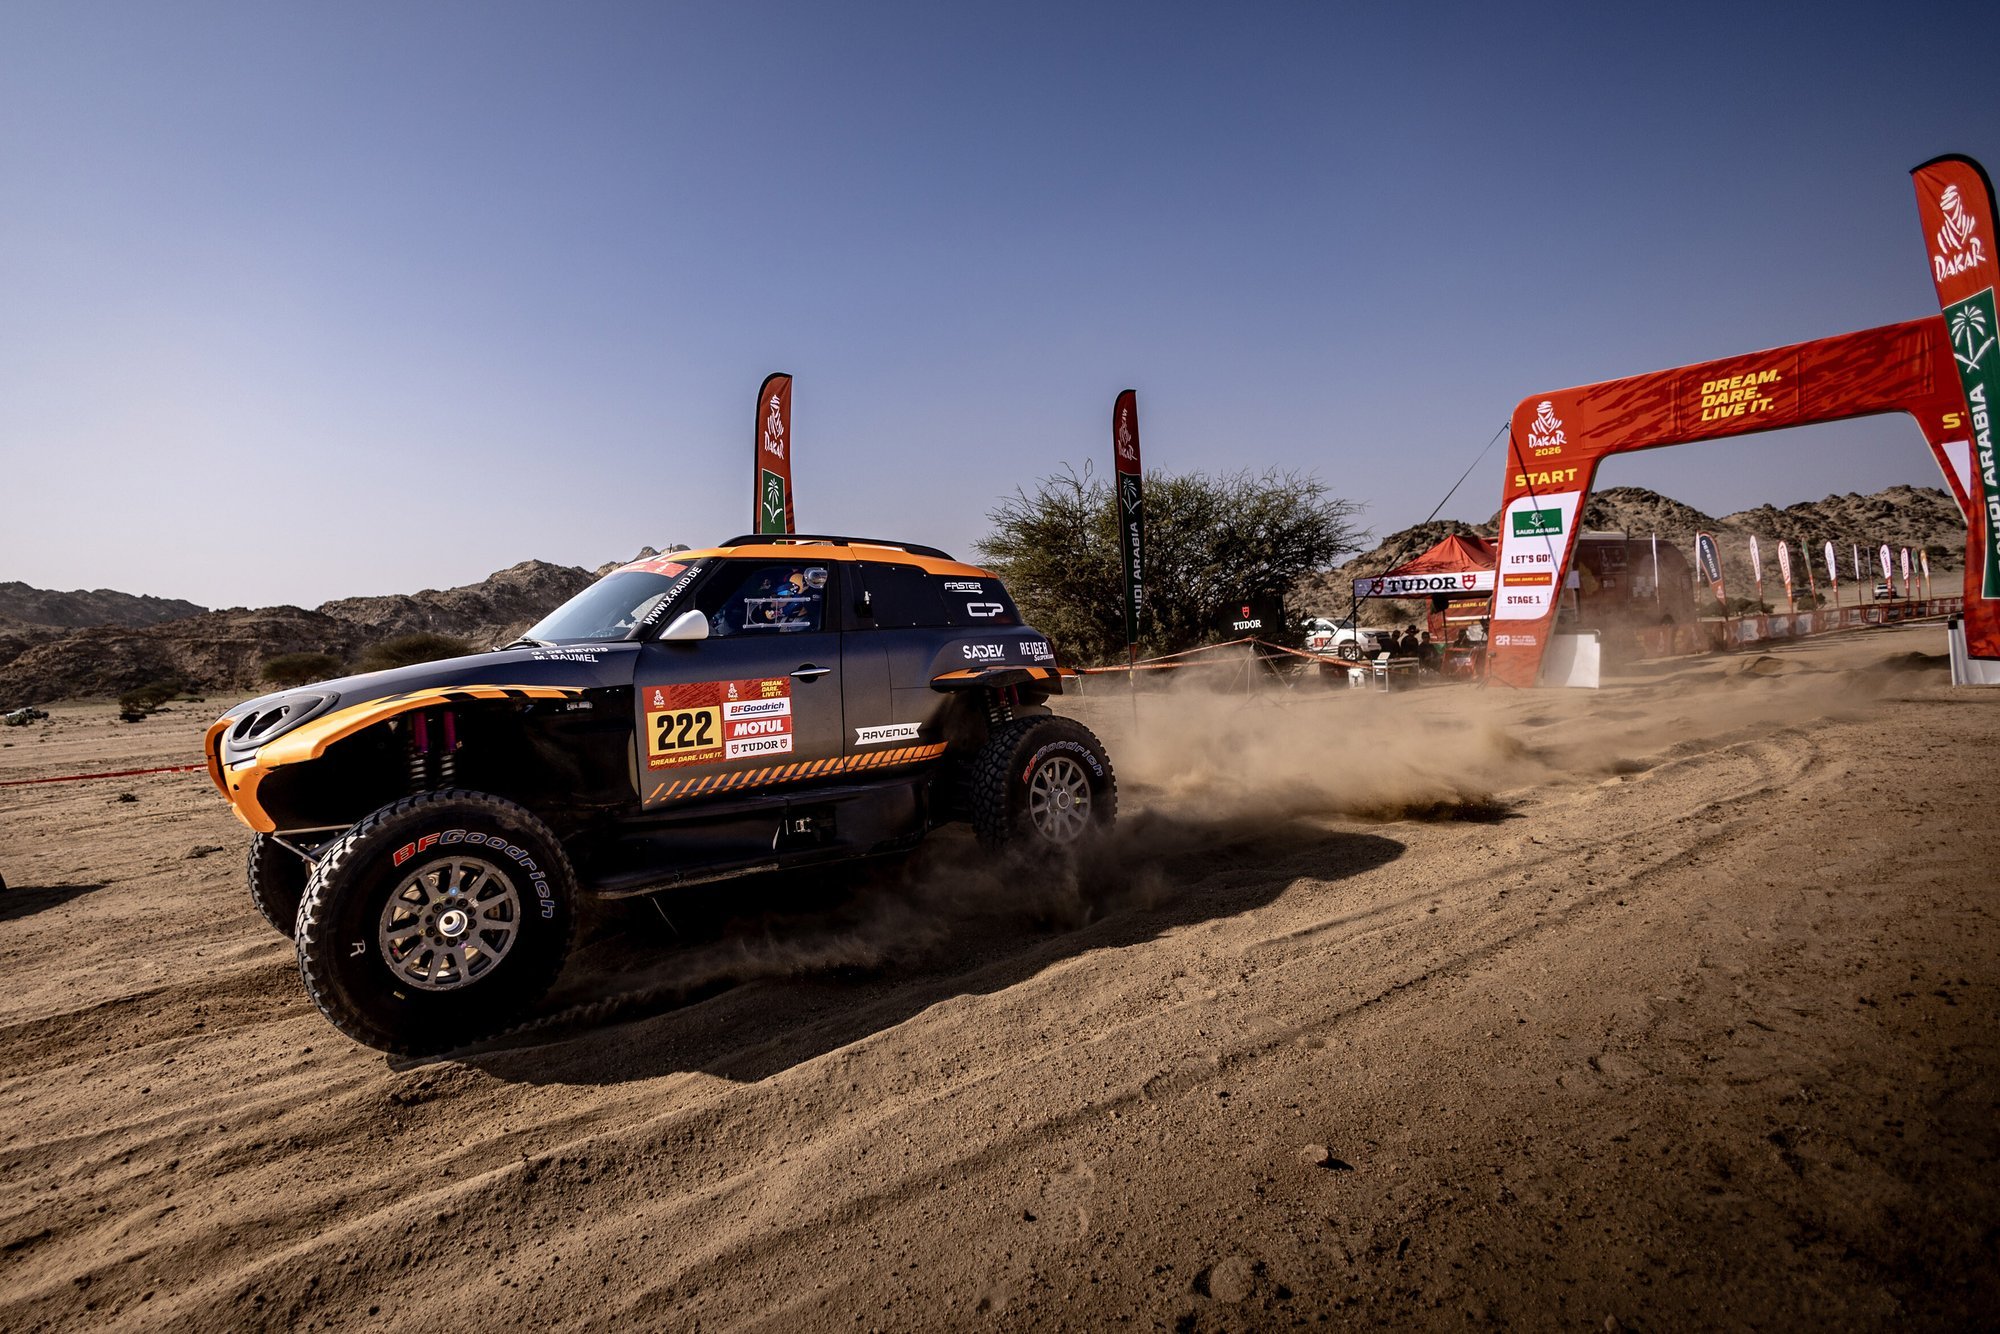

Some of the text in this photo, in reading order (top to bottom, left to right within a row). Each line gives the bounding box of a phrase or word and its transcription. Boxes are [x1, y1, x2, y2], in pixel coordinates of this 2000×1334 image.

[1935, 236, 1986, 283] DAKAR
[1701, 369, 1782, 395] DREAM.
[1701, 387, 1762, 408] DARE.
[1701, 397, 1775, 421] LIVE IT.
[1528, 430, 1567, 448] DAKAR
[1969, 384, 1998, 487] ARABIA
[1535, 446, 1561, 457] 2026
[1515, 468, 1577, 487] START
[1130, 521, 1142, 580] ARABIA
[1511, 554, 1551, 564] LET'S GO!
[1701, 539, 1718, 578] DEFENDER
[944, 582, 982, 590] FASTER
[1388, 576, 1458, 592] TUDOR
[643, 566, 702, 626] WWW.X-RAID.DE
[1507, 596, 1541, 604] STAGE 1
[1233, 619, 1262, 631] TUDOR
[1019, 642, 1049, 656] REIGER
[550, 654, 599, 663] BAUMEL
[731, 702, 784, 713] BFGoodrich
[656, 711, 714, 751] 222
[733, 719, 784, 736] MOTUL
[862, 727, 914, 740] RAVENOL
[741, 740, 778, 753] TUDOR
[651, 758, 677, 767] DREAM.
[678, 755, 698, 763] DARE.
[1022, 741, 1104, 784] BFGoodrich
[393, 829, 555, 920] BFGoodrich
